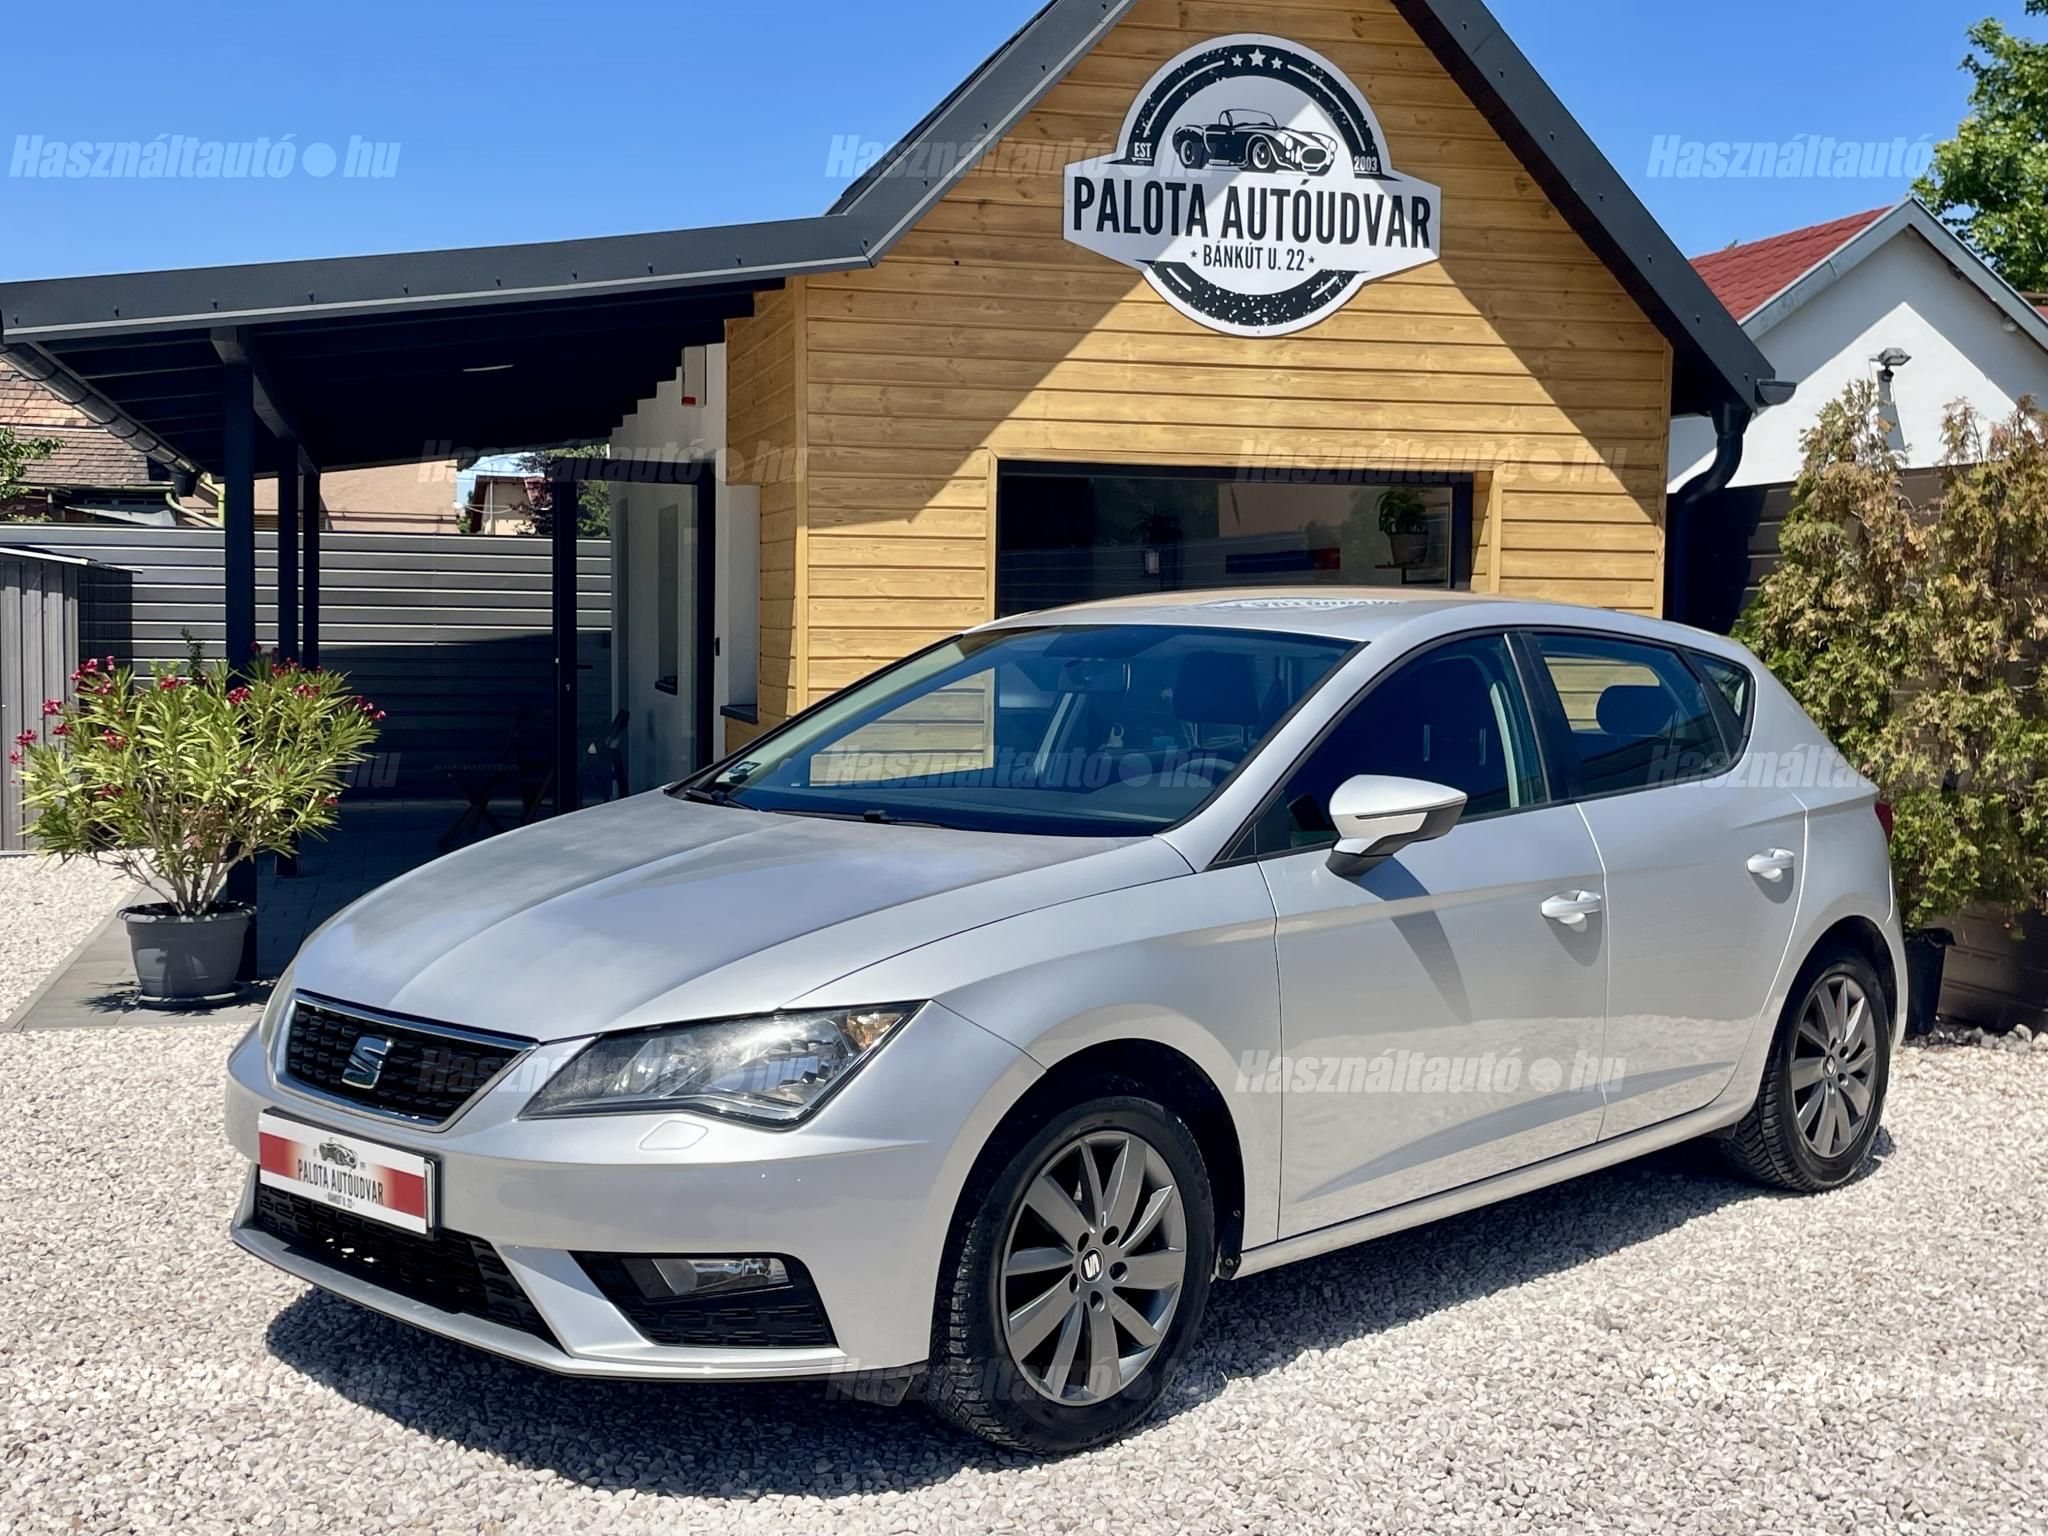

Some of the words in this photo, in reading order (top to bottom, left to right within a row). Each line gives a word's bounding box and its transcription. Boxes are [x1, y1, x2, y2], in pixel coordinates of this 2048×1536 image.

[1134, 142, 1152, 158] EST
[1354, 157, 1377, 173] 2003
[1073, 176, 1208, 238] PALOTA
[1220, 179, 1431, 249] AUTÓUDVAR
[1203, 240, 1263, 268] BÁNKÚT
[1268, 249, 1281, 271] U.
[1286, 249, 1305, 272] 22
[298, 1159, 329, 1190] PALOTA
